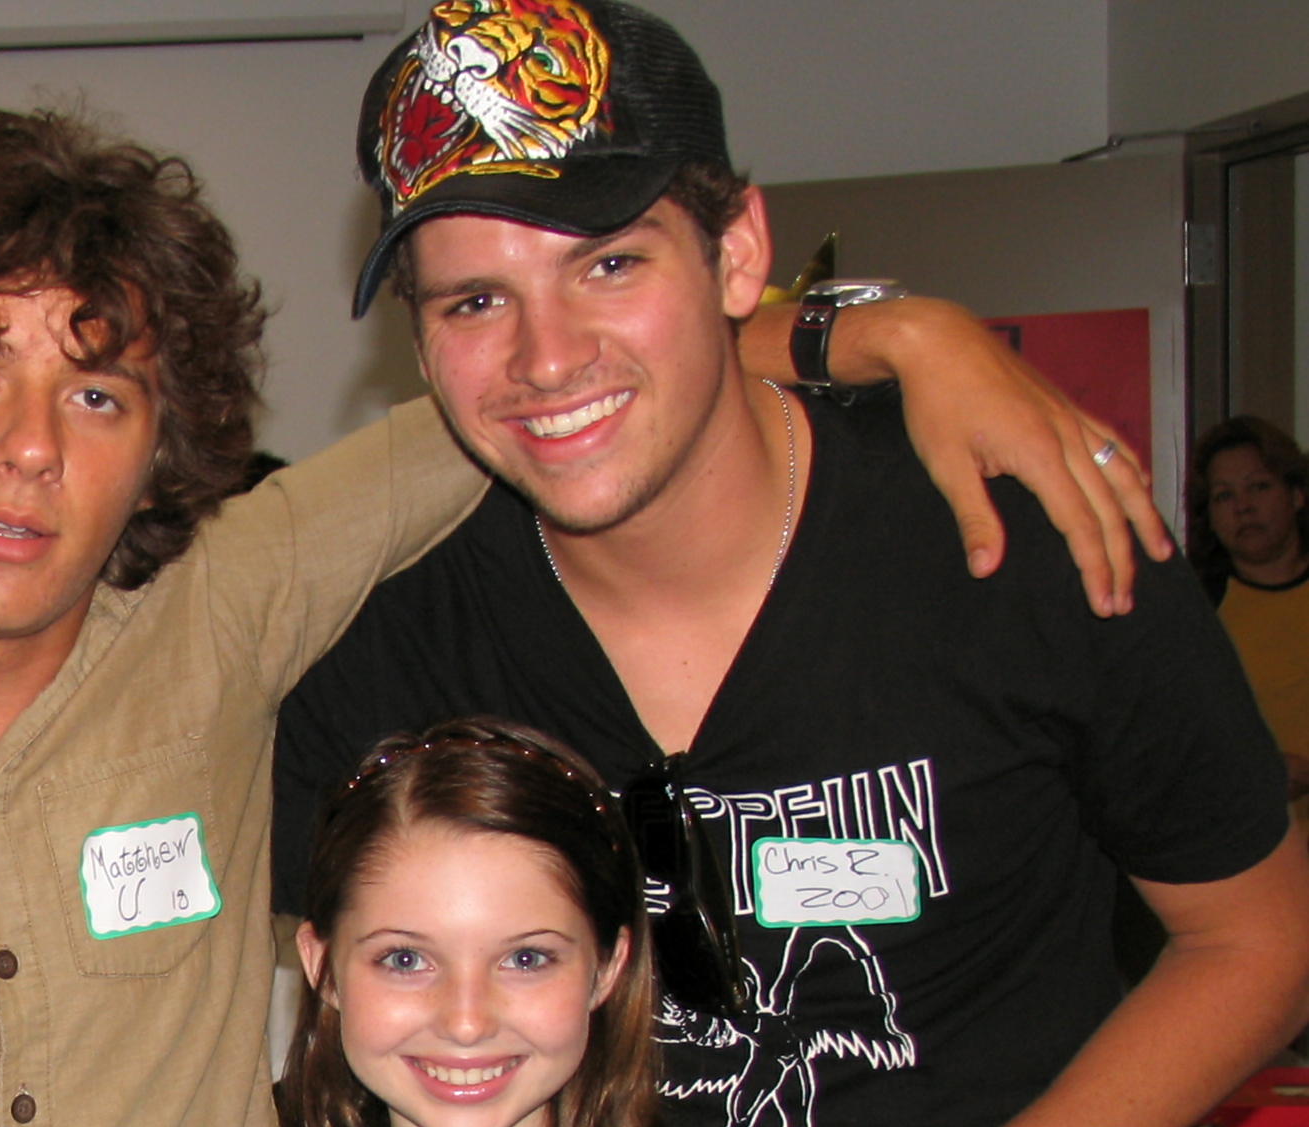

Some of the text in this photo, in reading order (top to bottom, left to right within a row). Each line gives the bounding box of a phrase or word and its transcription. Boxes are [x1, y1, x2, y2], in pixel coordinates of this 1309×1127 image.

[89, 827, 195, 890] Matthew
[764, 847, 839, 875] Chris
[171, 888, 191, 911] 18
